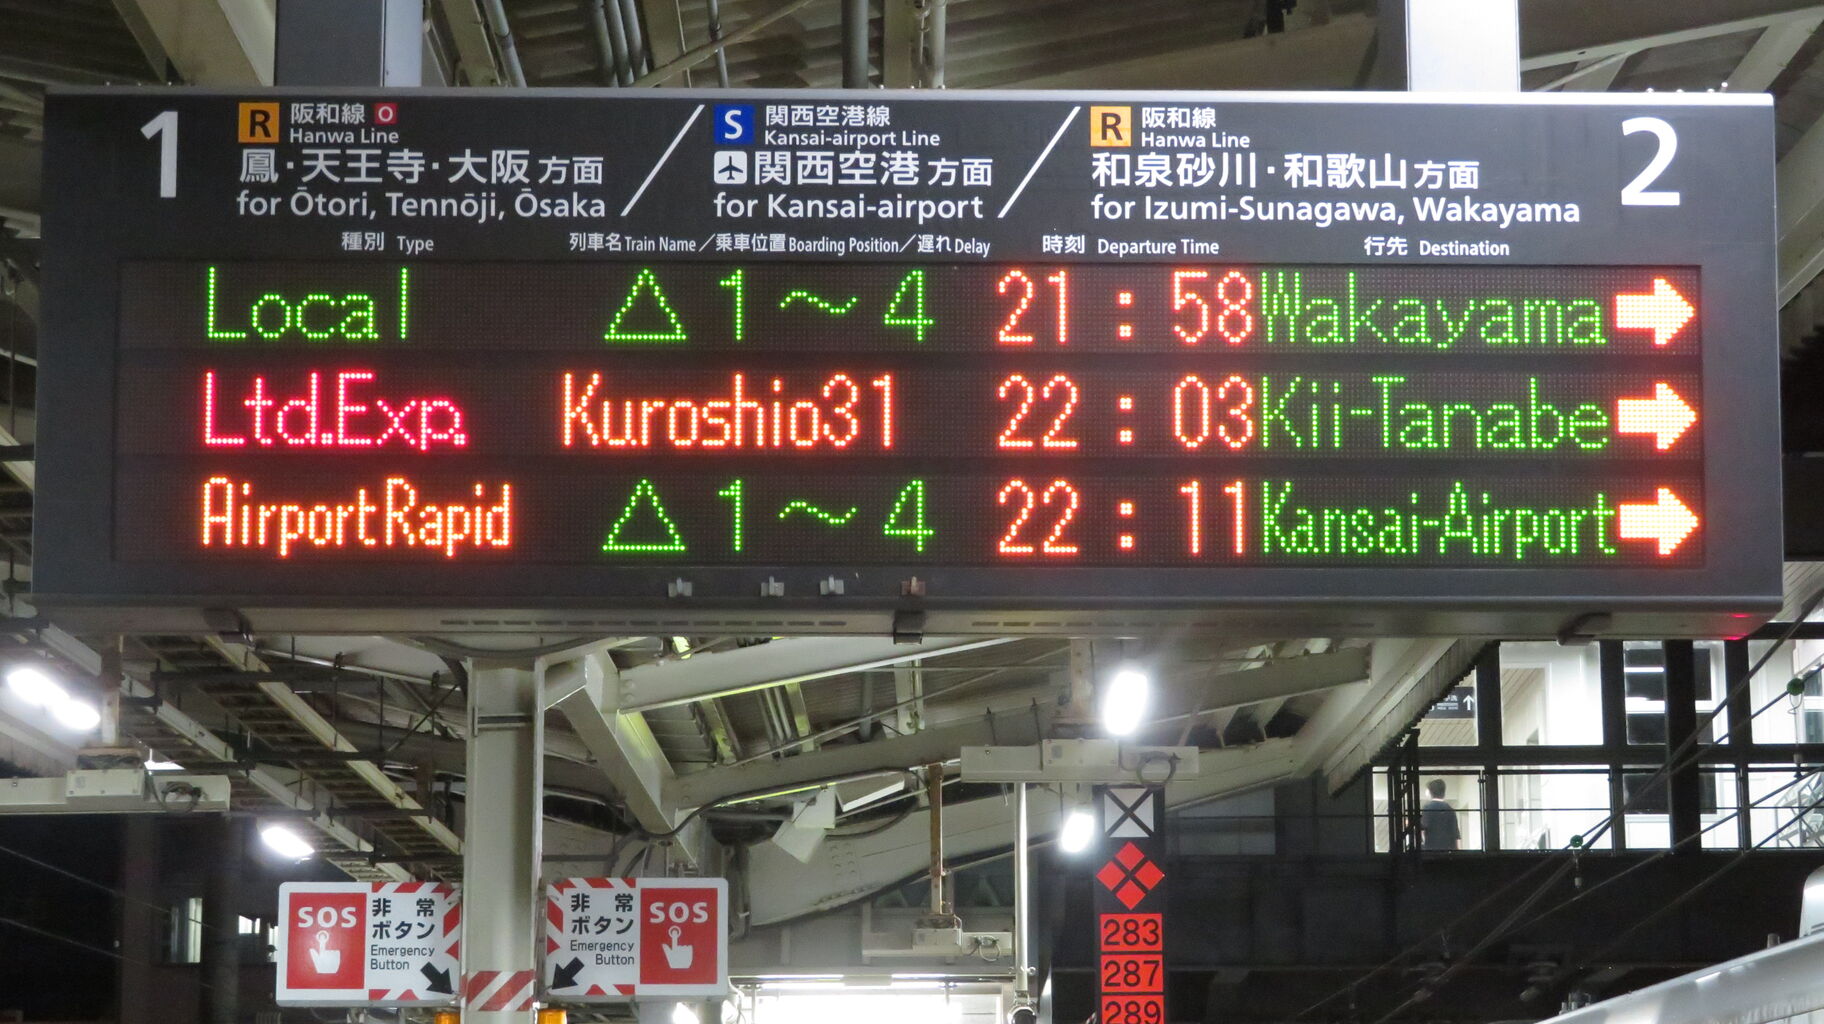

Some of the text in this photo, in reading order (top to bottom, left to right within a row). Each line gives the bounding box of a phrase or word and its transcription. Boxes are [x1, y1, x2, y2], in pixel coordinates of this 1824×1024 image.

[250, 109, 271, 138] R
[290, 102, 366, 125] 阪和線
[377, 105, 394, 123] O
[724, 109, 743, 140] S
[765, 105, 891, 128] 関西空港線
[1141, 106, 1217, 129] 阪和線
[289, 128, 399, 144] Hanwa Line
[1100, 111, 1123, 142] R
[764, 131, 940, 148] Kansai-airport Line
[1141, 132, 1250, 149] Hanwa Line
[140, 110, 179, 199] 1
[1620, 116, 1681, 207] 2
[539, 156, 604, 184] 方面
[754, 151, 993, 187] 関西空港 方面
[1091, 153, 1479, 190] 和泉砂川・和歌山 方面
[237, 191, 281, 215] for
[714, 193, 983, 225] for Kansai-airport
[1091, 195, 1580, 227] for Izumi-Sunagawa, Wakayama
[341, 231, 385, 251] 種別
[397, 235, 434, 252] Type
[569, 232, 622, 251] 列車名
[624, 236, 696, 253] Train Name
[715, 233, 786, 253] 乗車位置
[789, 236, 899, 256] Boarding Position
[917, 234, 951, 253] 遅れ
[954, 237, 991, 257] Delay
[1042, 235, 1085, 255] 時刻
[1097, 238, 1219, 257] Departure Time
[1363, 236, 1408, 257] 行先
[1418, 240, 1510, 257] Destination
[206, 266, 409, 341] Local
[1260, 270, 1607, 349] Wakayama
[1262, 376, 1609, 448] Kii-Tanabe
[1262, 480, 1616, 559] Kansai-Airport
[298, 906, 357, 929] SOS
[649, 901, 709, 924] SOS
[372, 920, 436, 940] ボタン
[571, 916, 635, 936] ボタン
[1103, 918, 1160, 946] 283
[370, 944, 436, 959] Emergency
[569, 939, 635, 955] Emergency
[370, 958, 410, 970] Button
[595, 953, 635, 965] Button
[1104, 959, 1161, 988] 287
[1104, 1000, 1161, 1024] 289
